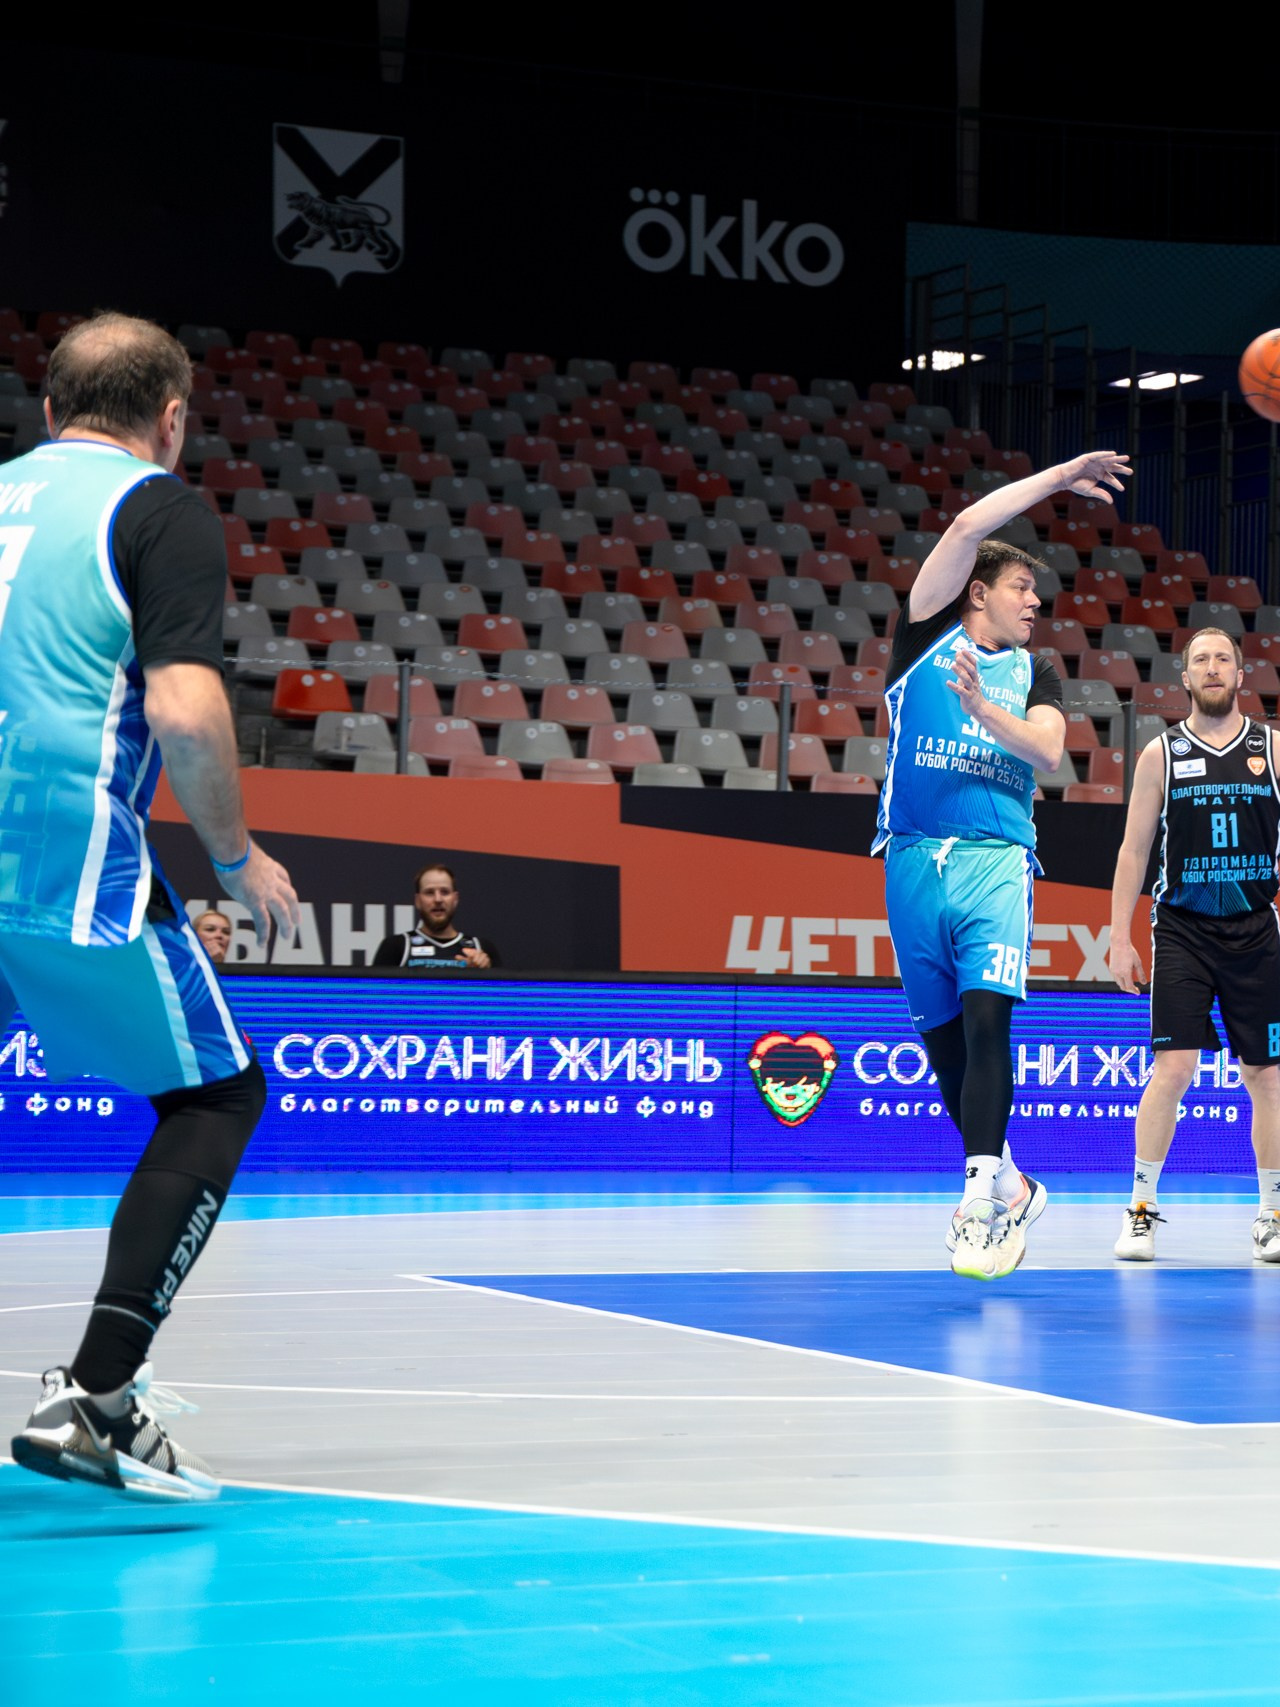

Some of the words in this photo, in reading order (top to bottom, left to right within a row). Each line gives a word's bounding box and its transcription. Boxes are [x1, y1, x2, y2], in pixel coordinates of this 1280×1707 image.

[915, 752, 949, 770] КУБОК
[950, 757, 995, 780] РОССИИ
[996, 769, 1024, 791] 25/26
[1171, 783, 1272, 800] БЛАГОТВОРИТЕЛЬНЫЙ
[1193, 796, 1253, 806] МАТЧ
[1211, 812, 1239, 848] 81
[1207, 869, 1246, 882] РОССИИ
[982, 943, 1020, 987] 38
[273, 1034, 533, 1081] СОХРАНИ
[548, 1037, 722, 1083] ЖИЗНЬ
[26, 1093, 114, 1116] фонд
[280, 1094, 618, 1117] благотворительный
[636, 1096, 713, 1118] фонд
[171, 1190, 218, 1276] NIKE
